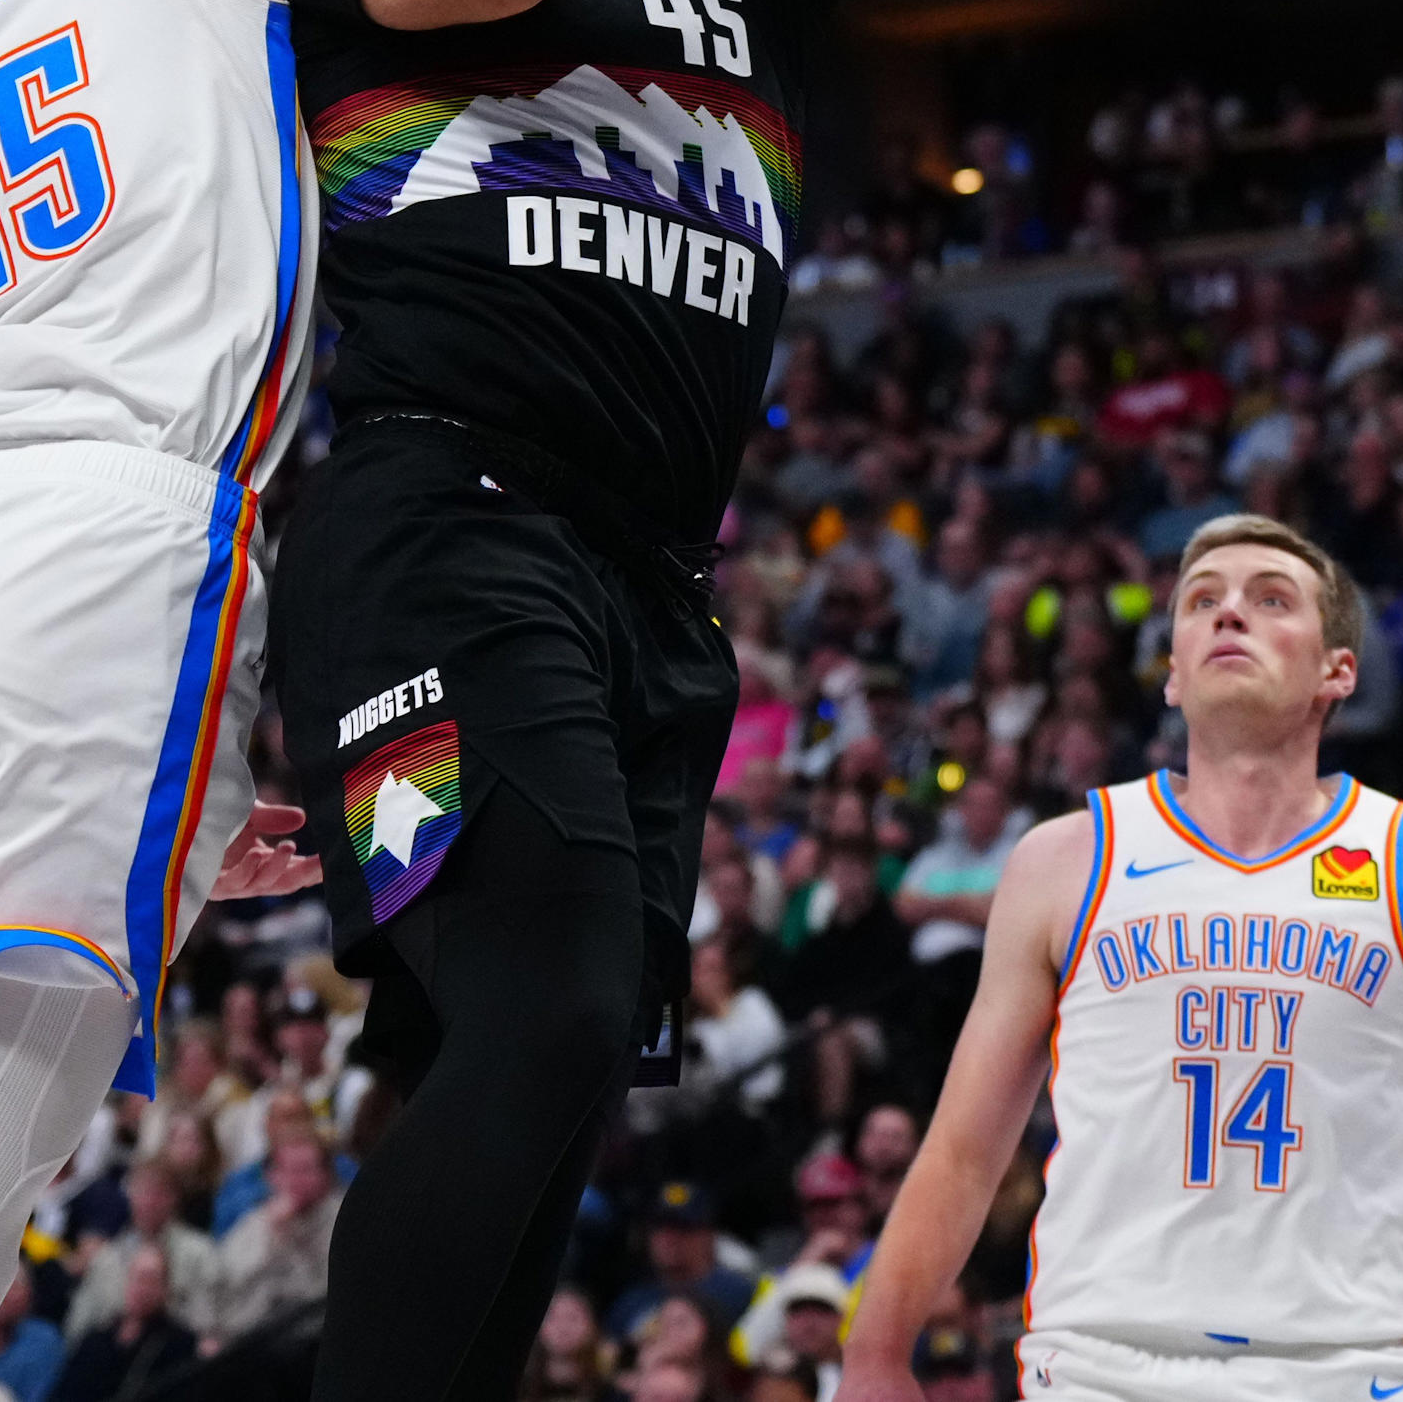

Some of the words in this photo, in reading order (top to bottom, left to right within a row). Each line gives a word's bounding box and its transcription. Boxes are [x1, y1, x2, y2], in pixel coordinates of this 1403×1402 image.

[506, 195, 756, 327] DENVER
[337, 667, 444, 749] NUGGETS
[1093, 912, 1394, 1006] OKLAHOMA
[1175, 986, 1303, 1055] CITY
[1174, 1057, 1302, 1192] 14
